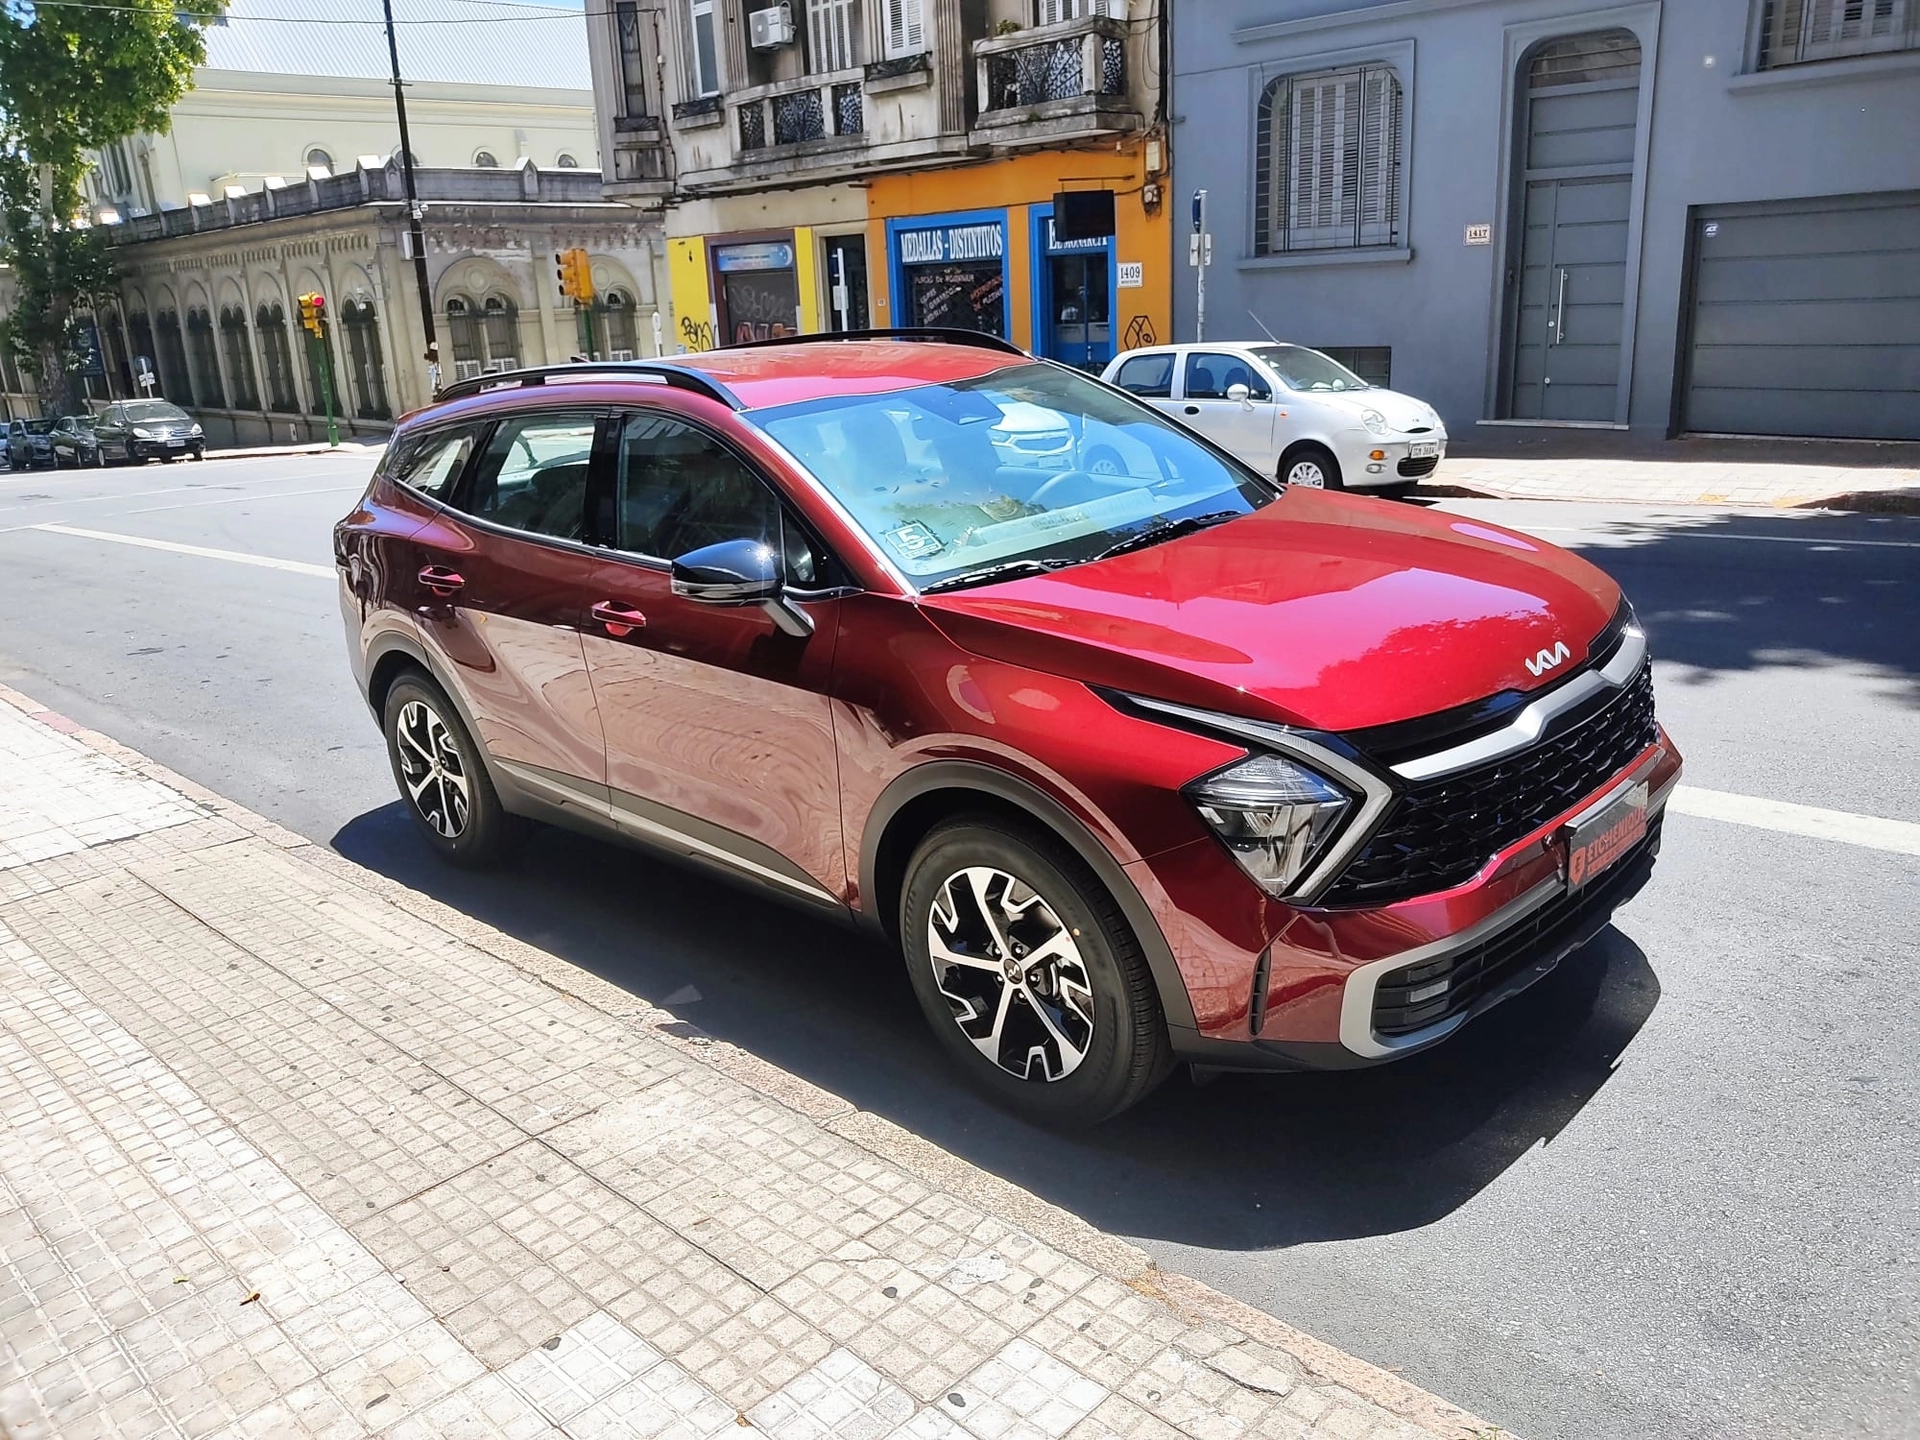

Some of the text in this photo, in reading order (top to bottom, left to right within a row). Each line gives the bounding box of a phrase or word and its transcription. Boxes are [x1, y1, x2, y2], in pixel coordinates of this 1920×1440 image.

[900, 229, 943, 263] MEDALLAS
[948, 224, 1003, 260] DISTINTIVOS
[1469, 229, 1488, 237] 1417
[1120, 266, 1140, 279] 1409
[1525, 641, 1570, 676] KIA
[1587, 808, 1647, 860] ETCHENIQUE
